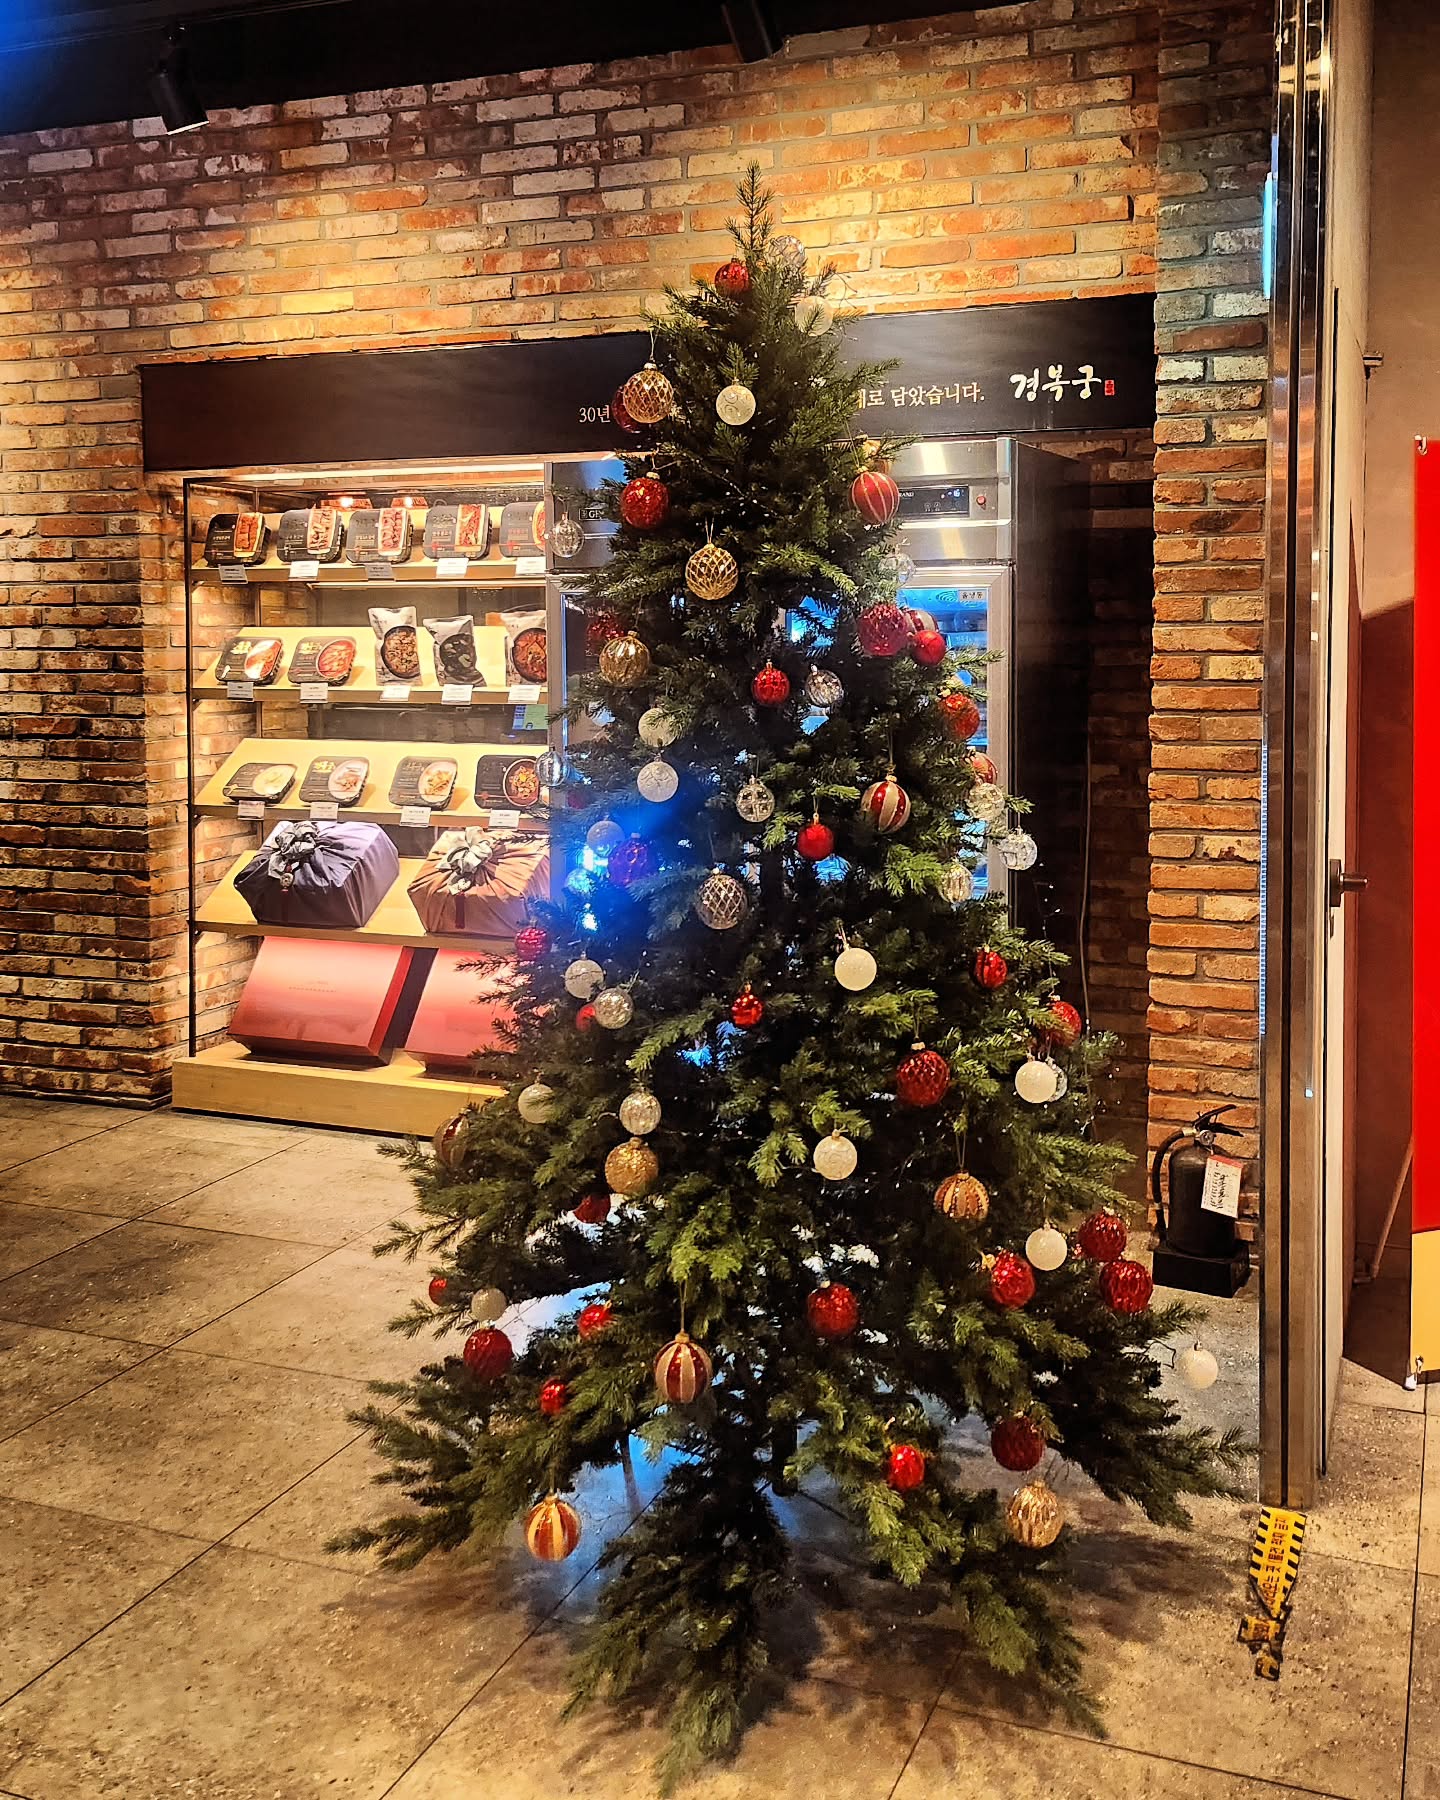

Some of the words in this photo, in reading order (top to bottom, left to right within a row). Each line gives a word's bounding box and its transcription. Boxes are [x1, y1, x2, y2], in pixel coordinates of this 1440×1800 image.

[579, 404, 611, 423] 30년
[890, 381, 985, 407] 담았습니다.
[1009, 364, 1102, 402] 경복궁
